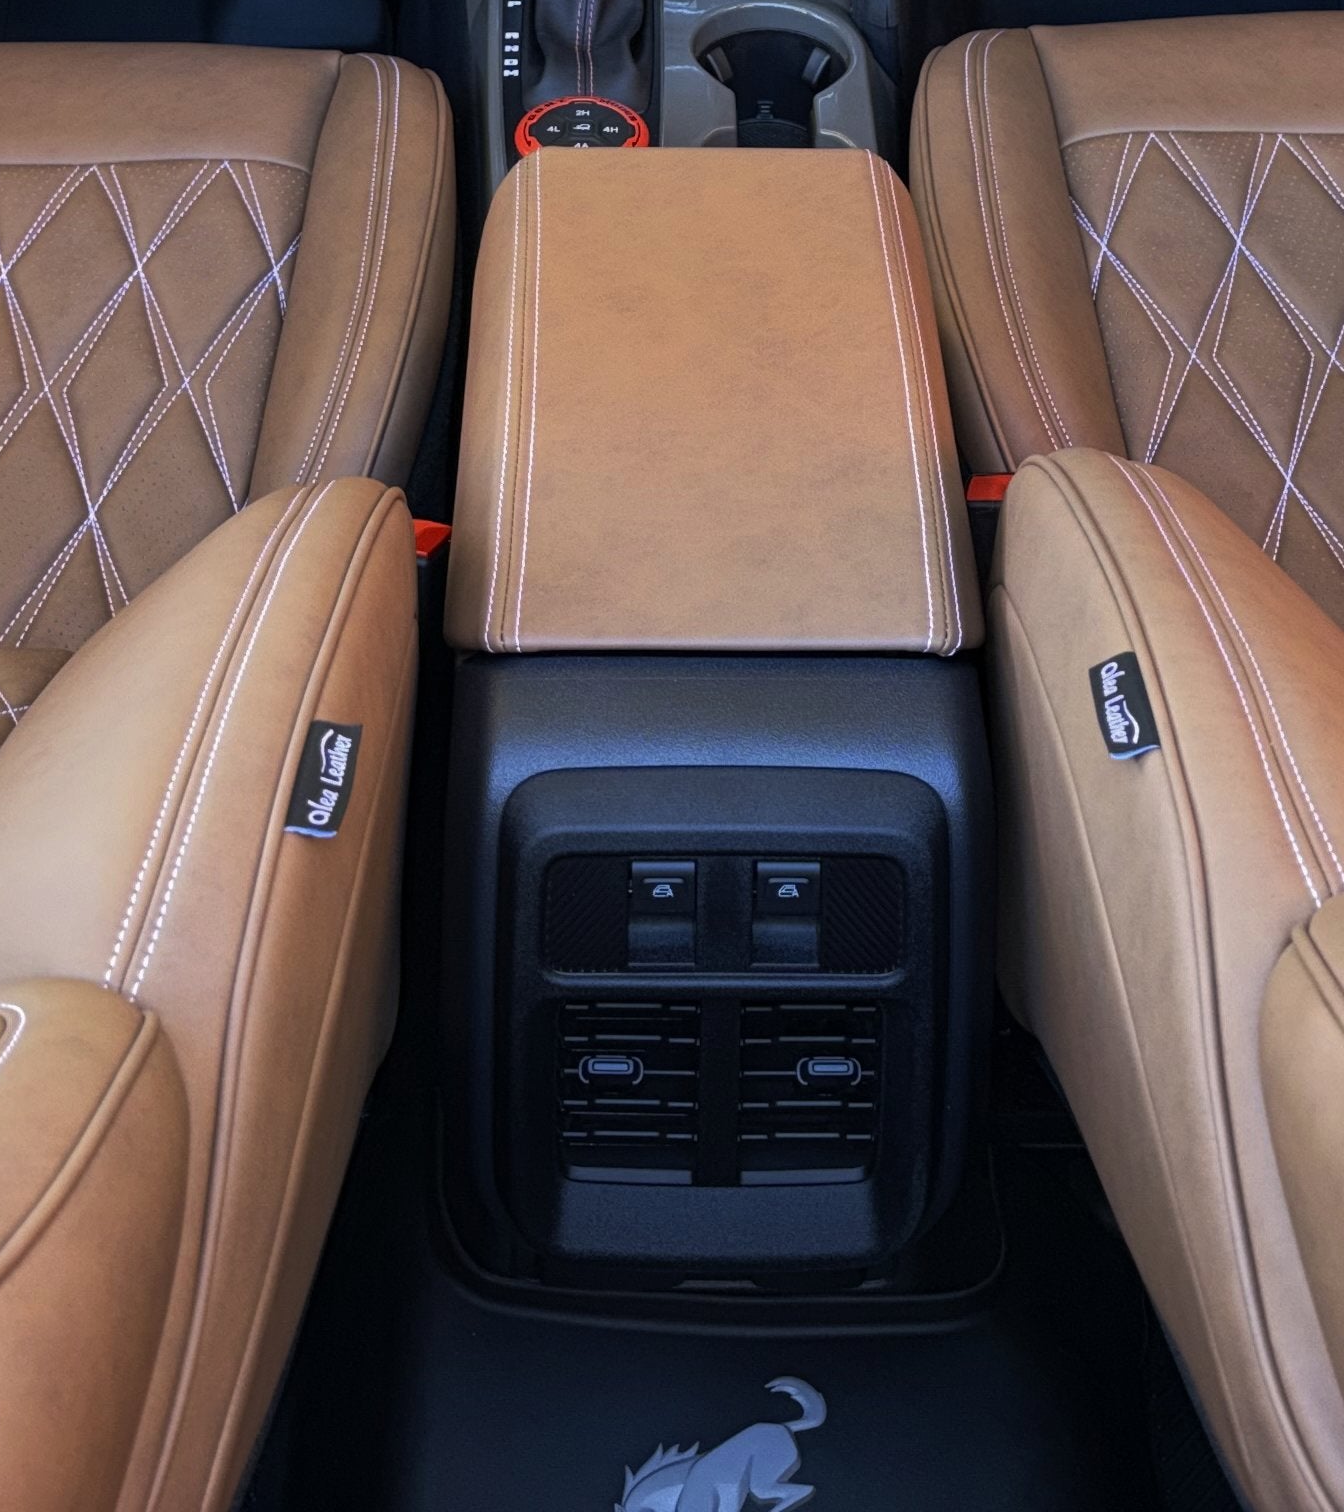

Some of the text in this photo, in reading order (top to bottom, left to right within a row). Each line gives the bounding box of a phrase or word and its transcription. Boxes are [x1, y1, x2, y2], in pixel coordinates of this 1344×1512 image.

[575, 109, 591, 117] 2H
[602, 126, 619, 134] 4H
[1104, 694, 1130, 744] Leather
[320, 733, 353, 787] Leather
